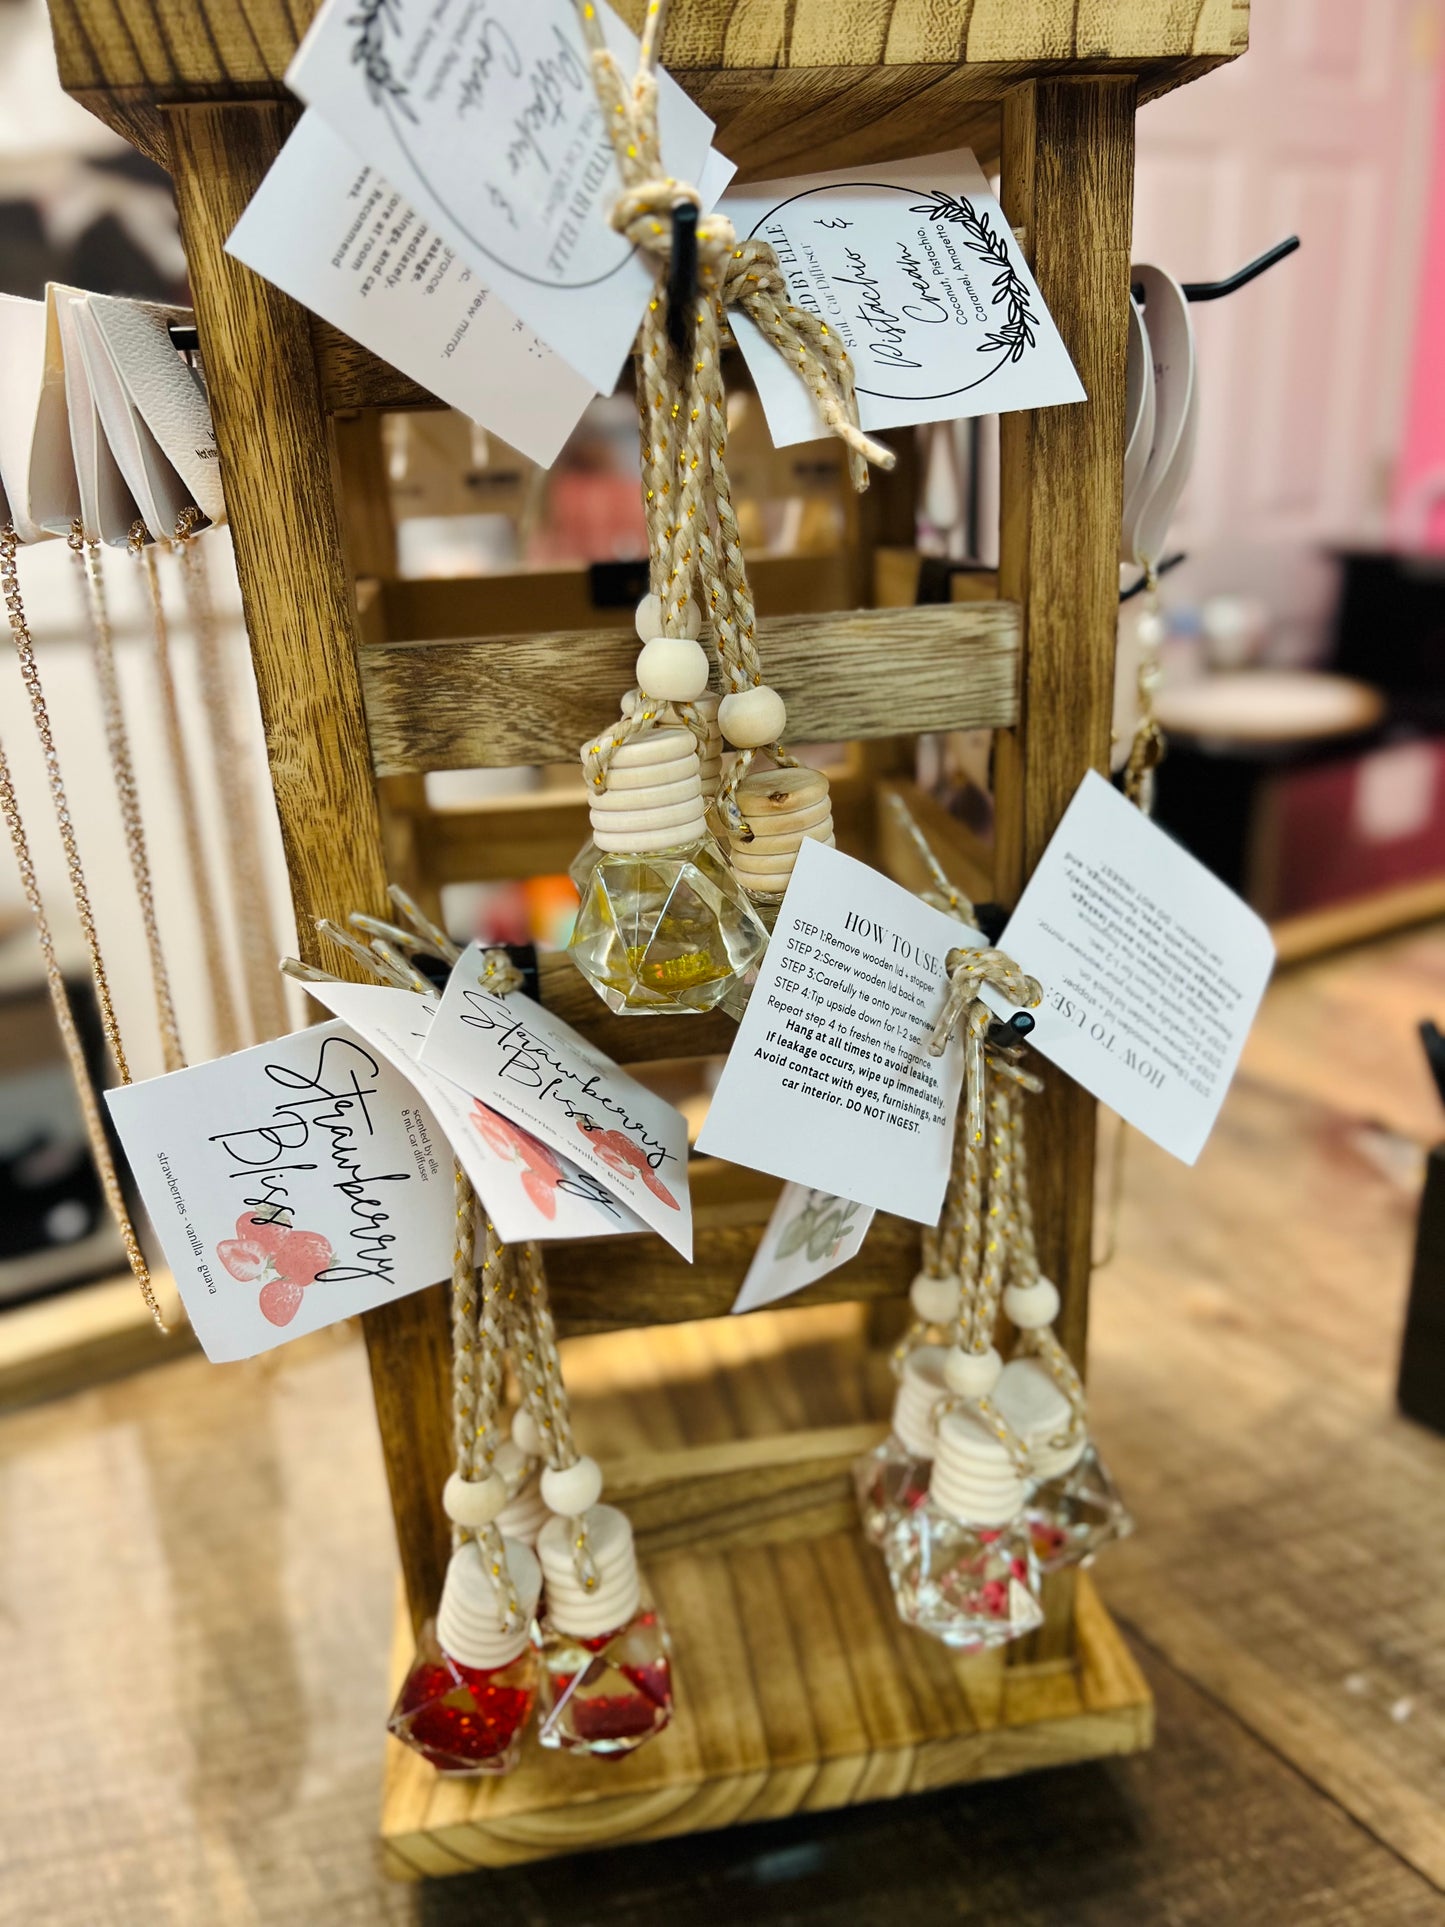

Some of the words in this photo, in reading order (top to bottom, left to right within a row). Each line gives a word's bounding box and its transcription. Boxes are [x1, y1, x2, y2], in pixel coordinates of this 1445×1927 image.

[332, 190, 382, 268] Recommend
[373, 222, 384, 236] at
[766, 224, 797, 268] ELLE
[813, 217, 854, 230] &
[352, 237, 375, 271] room
[373, 250, 390, 275] and
[386, 225, 427, 288] mediately.
[412, 238, 442, 281] eakage.
[801, 243, 830, 290] Diffuser
[917, 227, 944, 275] Pistachio,
[936, 224, 966, 272] Amaretto
[360, 276, 375, 297] car
[788, 271, 809, 289] BY
[824, 292, 841, 315] Car
[897, 242, 949, 323] Cream
[940, 278, 968, 325] Coconut,
[957, 274, 987, 322] Caramel,
[832, 247, 922, 368] Pistachio
[441, 320, 469, 358] mirror.
[793, 919, 818, 936] STEP
[820, 930, 860, 956] 1:Remove
[863, 952, 893, 971] wooden
[895, 964, 904, 977] lid
[910, 975, 935, 994] stopper.
[845, 912, 887, 944] HOW
[892, 934, 911, 958] TO
[915, 948, 948, 977] USE:
[780, 957, 806, 974] STEP
[807, 968, 857, 999] 3:Carefully
[859, 990, 870, 1002] tie
[872, 997, 890, 1011] onto
[890, 1006, 908, 1018] your
[787, 938, 812, 955] STEP
[813, 949, 851, 973] 2:Screw
[854, 969, 886, 988] wooden
[887, 980, 898, 994] lid
[898, 986, 915, 1002] back
[916, 998, 926, 1008] on.
[1063, 976, 1097, 1005] stopper.
[774, 976, 800, 992] STEP
[801, 987, 824, 1006] 4:Tip
[826, 1000, 856, 1017] upside
[858, 1010, 882, 1027] down
[883, 1019, 895, 1032] for
[897, 1025, 908, 1039] 1-2
[909, 1034, 925, 1046] sec.
[1039, 987, 1086, 1028] USE:
[767, 995, 803, 1017] Repeat
[805, 1012, 826, 1028] step
[828, 1019, 836, 1029] 4
[837, 1023, 847, 1034] to
[849, 1026, 881, 1047] freshen
[883, 1040, 896, 1054] the
[898, 1045, 931, 1069] fragrance.
[786, 1019, 814, 1040] Hang
[815, 1032, 827, 1043] at
[828, 1037, 842, 1049] all
[844, 1042, 870, 1059] times
[873, 1053, 883, 1064] to
[884, 1059, 909, 1074] avoid
[909, 1066, 938, 1088] leakage.
[1090, 1023, 1115, 1052] TO
[460, 991, 678, 1169] Strawberry
[499, 1043, 604, 1132] Bliss
[754, 1048, 787, 1066] Avoid
[789, 1062, 829, 1082] contact
[832, 1077, 853, 1091] with
[855, 1086, 879, 1102] eyes,
[883, 1093, 930, 1121] furnishings,
[932, 1114, 947, 1126] and
[766, 1031, 777, 1042] If
[777, 1035, 817, 1058] leakage
[820, 1053, 855, 1074] occurs,
[859, 1067, 881, 1082] wipe
[883, 1076, 895, 1089] up
[896, 1079, 944, 1109] immediately.
[1120, 1049, 1165, 1088] HOW
[401, 1109, 410, 1117] 8
[403, 1118, 412, 1134] mL
[413, 1109, 431, 1144] scented
[782, 1078, 800, 1090] car
[801, 1082, 842, 1106] interior.
[846, 1098, 862, 1112] DO
[863, 1105, 886, 1120] NOT
[886, 1113, 920, 1133] INGEST.
[264, 1037, 411, 1285] Strawberry
[409, 1134, 418, 1147] car
[424, 1144, 433, 1156] by
[208, 1111, 318, 1229] Bliss
[414, 1149, 429, 1182] diffuser
[428, 1158, 438, 1175] elle
[157, 1151, 188, 1215] strawberries
[184, 1222, 205, 1260] vanilla
[197, 1262, 217, 1296] guava
